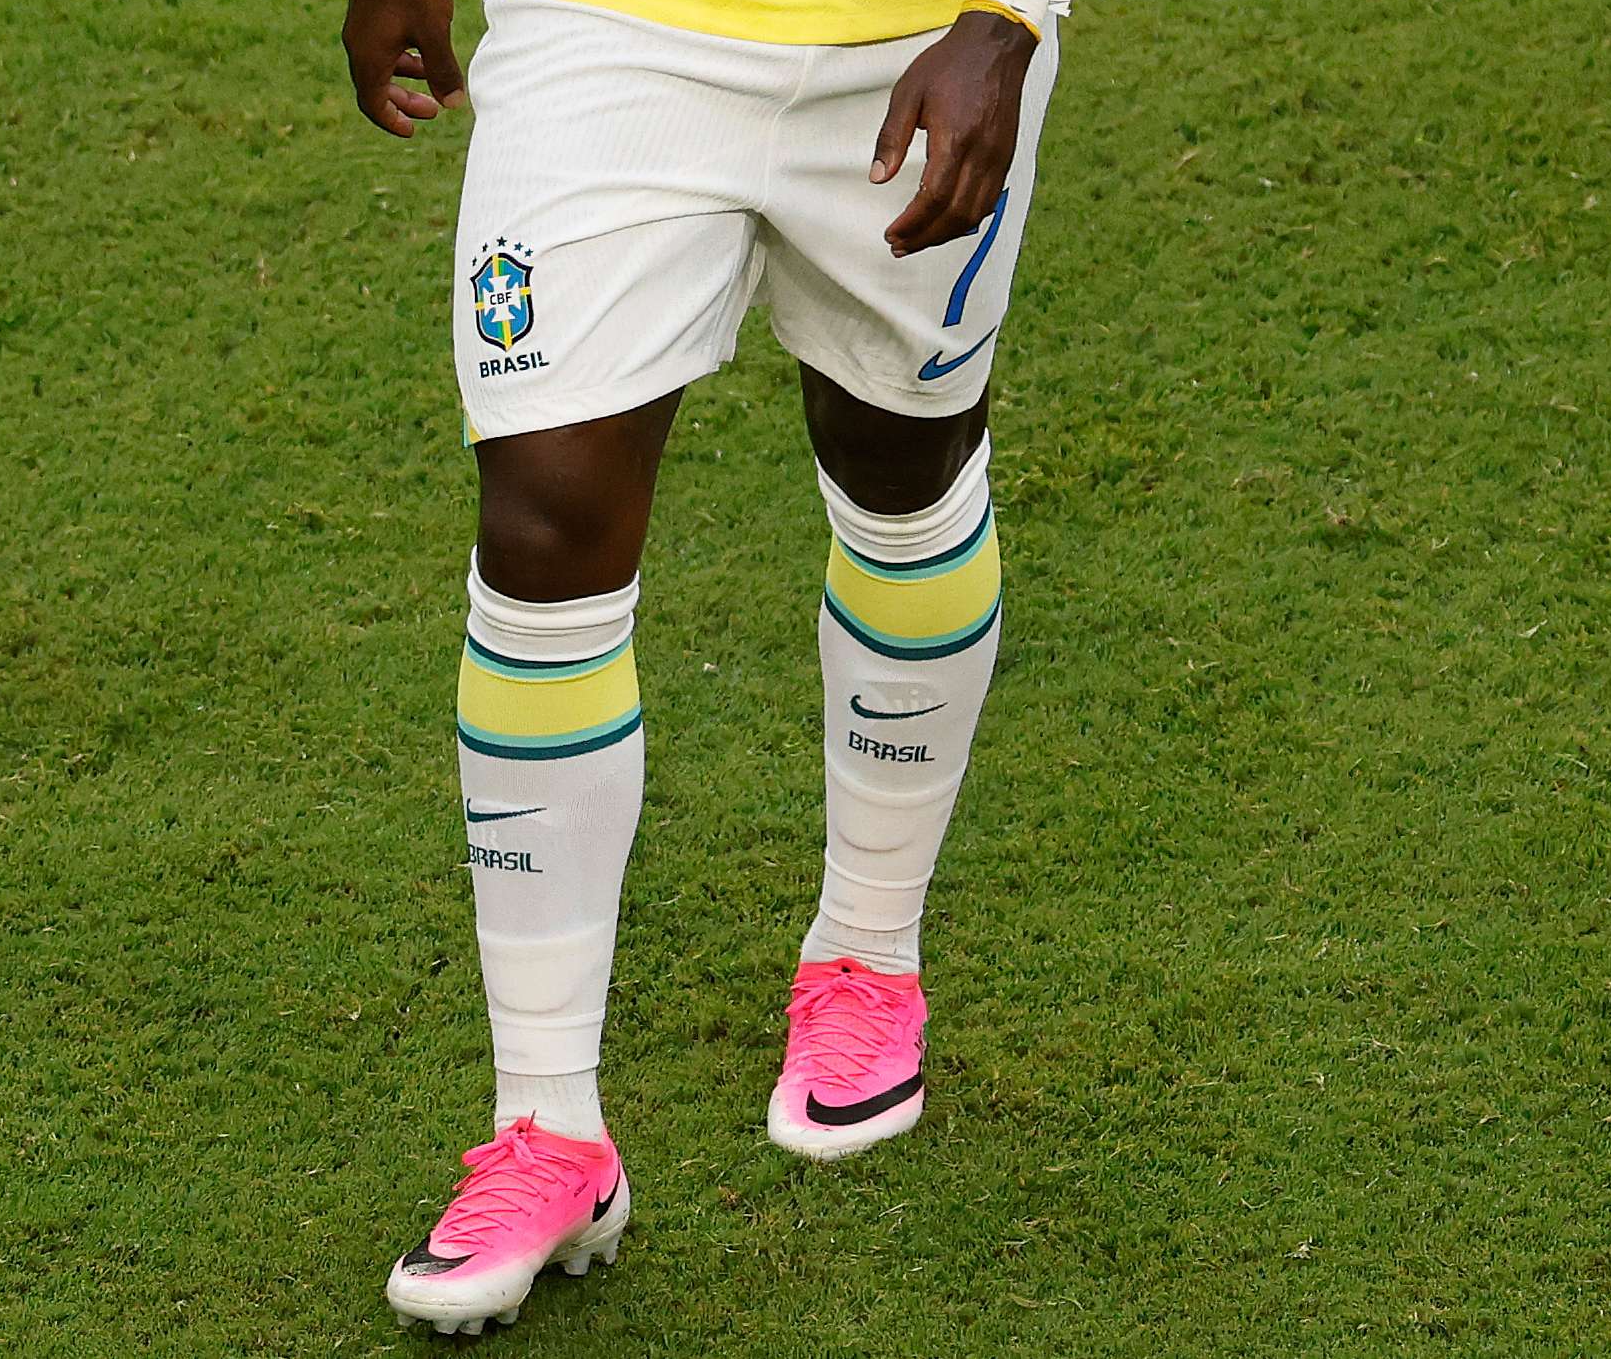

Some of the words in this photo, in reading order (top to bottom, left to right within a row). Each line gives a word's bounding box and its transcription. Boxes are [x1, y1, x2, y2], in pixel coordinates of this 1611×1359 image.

[942, 187, 1010, 328] 7
[490, 292, 513, 306] CBF
[479, 350, 550, 378] BRASIL
[848, 729, 935, 762] BRASIL
[467, 843, 543, 873] BRASIL
